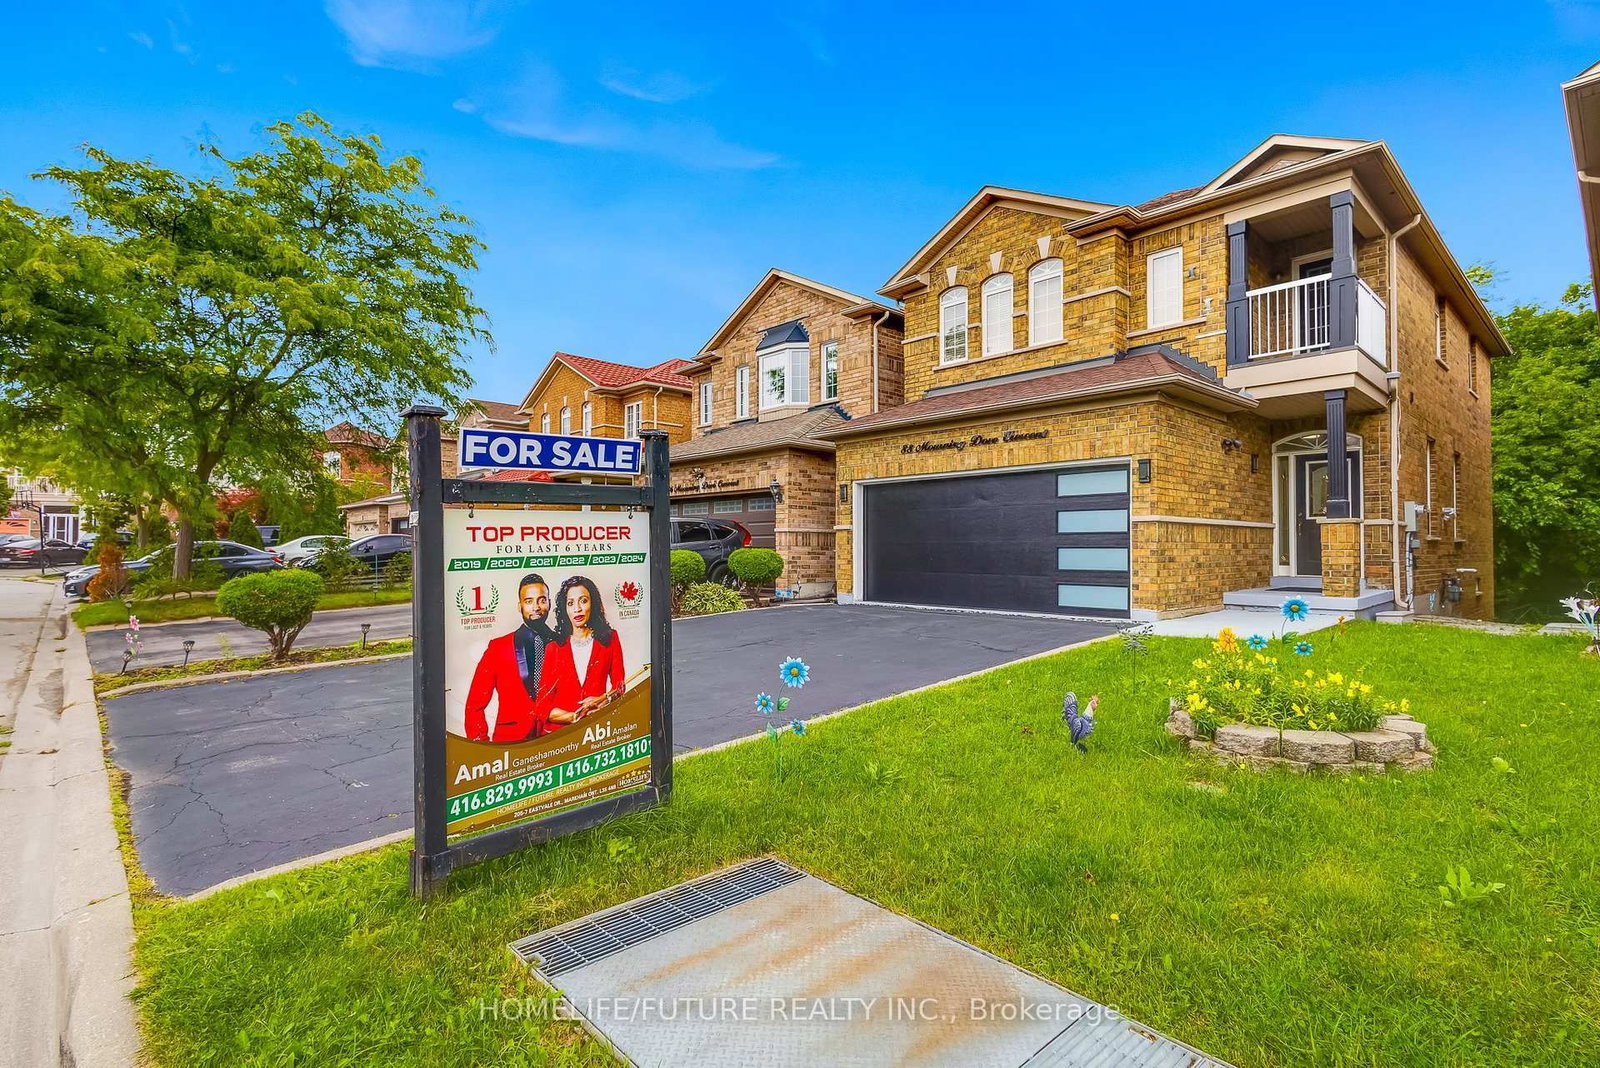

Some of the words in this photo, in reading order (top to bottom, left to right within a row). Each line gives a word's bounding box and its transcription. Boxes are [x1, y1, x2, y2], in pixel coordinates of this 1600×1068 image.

[969, 435, 999, 447] Dove
[465, 435, 542, 465] FOR
[551, 441, 634, 469] SALE
[466, 526, 515, 542] TOP
[520, 526, 631, 542] PRODUCER
[496, 545, 522, 554] FOR
[528, 544, 559, 553] LAST
[565, 544, 571, 552] 6
[575, 543, 612, 552] YEARS
[454, 559, 481, 570] 2019
[490, 559, 520, 568] 2020
[530, 558, 554, 567] 2021
[559, 557, 585, 566] 2022
[592, 556, 617, 564] 2023
[621, 555, 643, 563] 2024
[471, 586, 485, 611] 1
[581, 721, 611, 746] Abi
[612, 722, 638, 736] Amalan
[590, 742, 601, 751] Real
[453, 750, 510, 786] Amal
[512, 741, 580, 768] Ganeshamoorthy
[495, 771, 509, 781] Real
[509, 766, 527, 777] Estate
[527, 761, 545, 772] Broker
[450, 769, 553, 816] 416.829.9993
[565, 738, 648, 779] 416.732.1810
